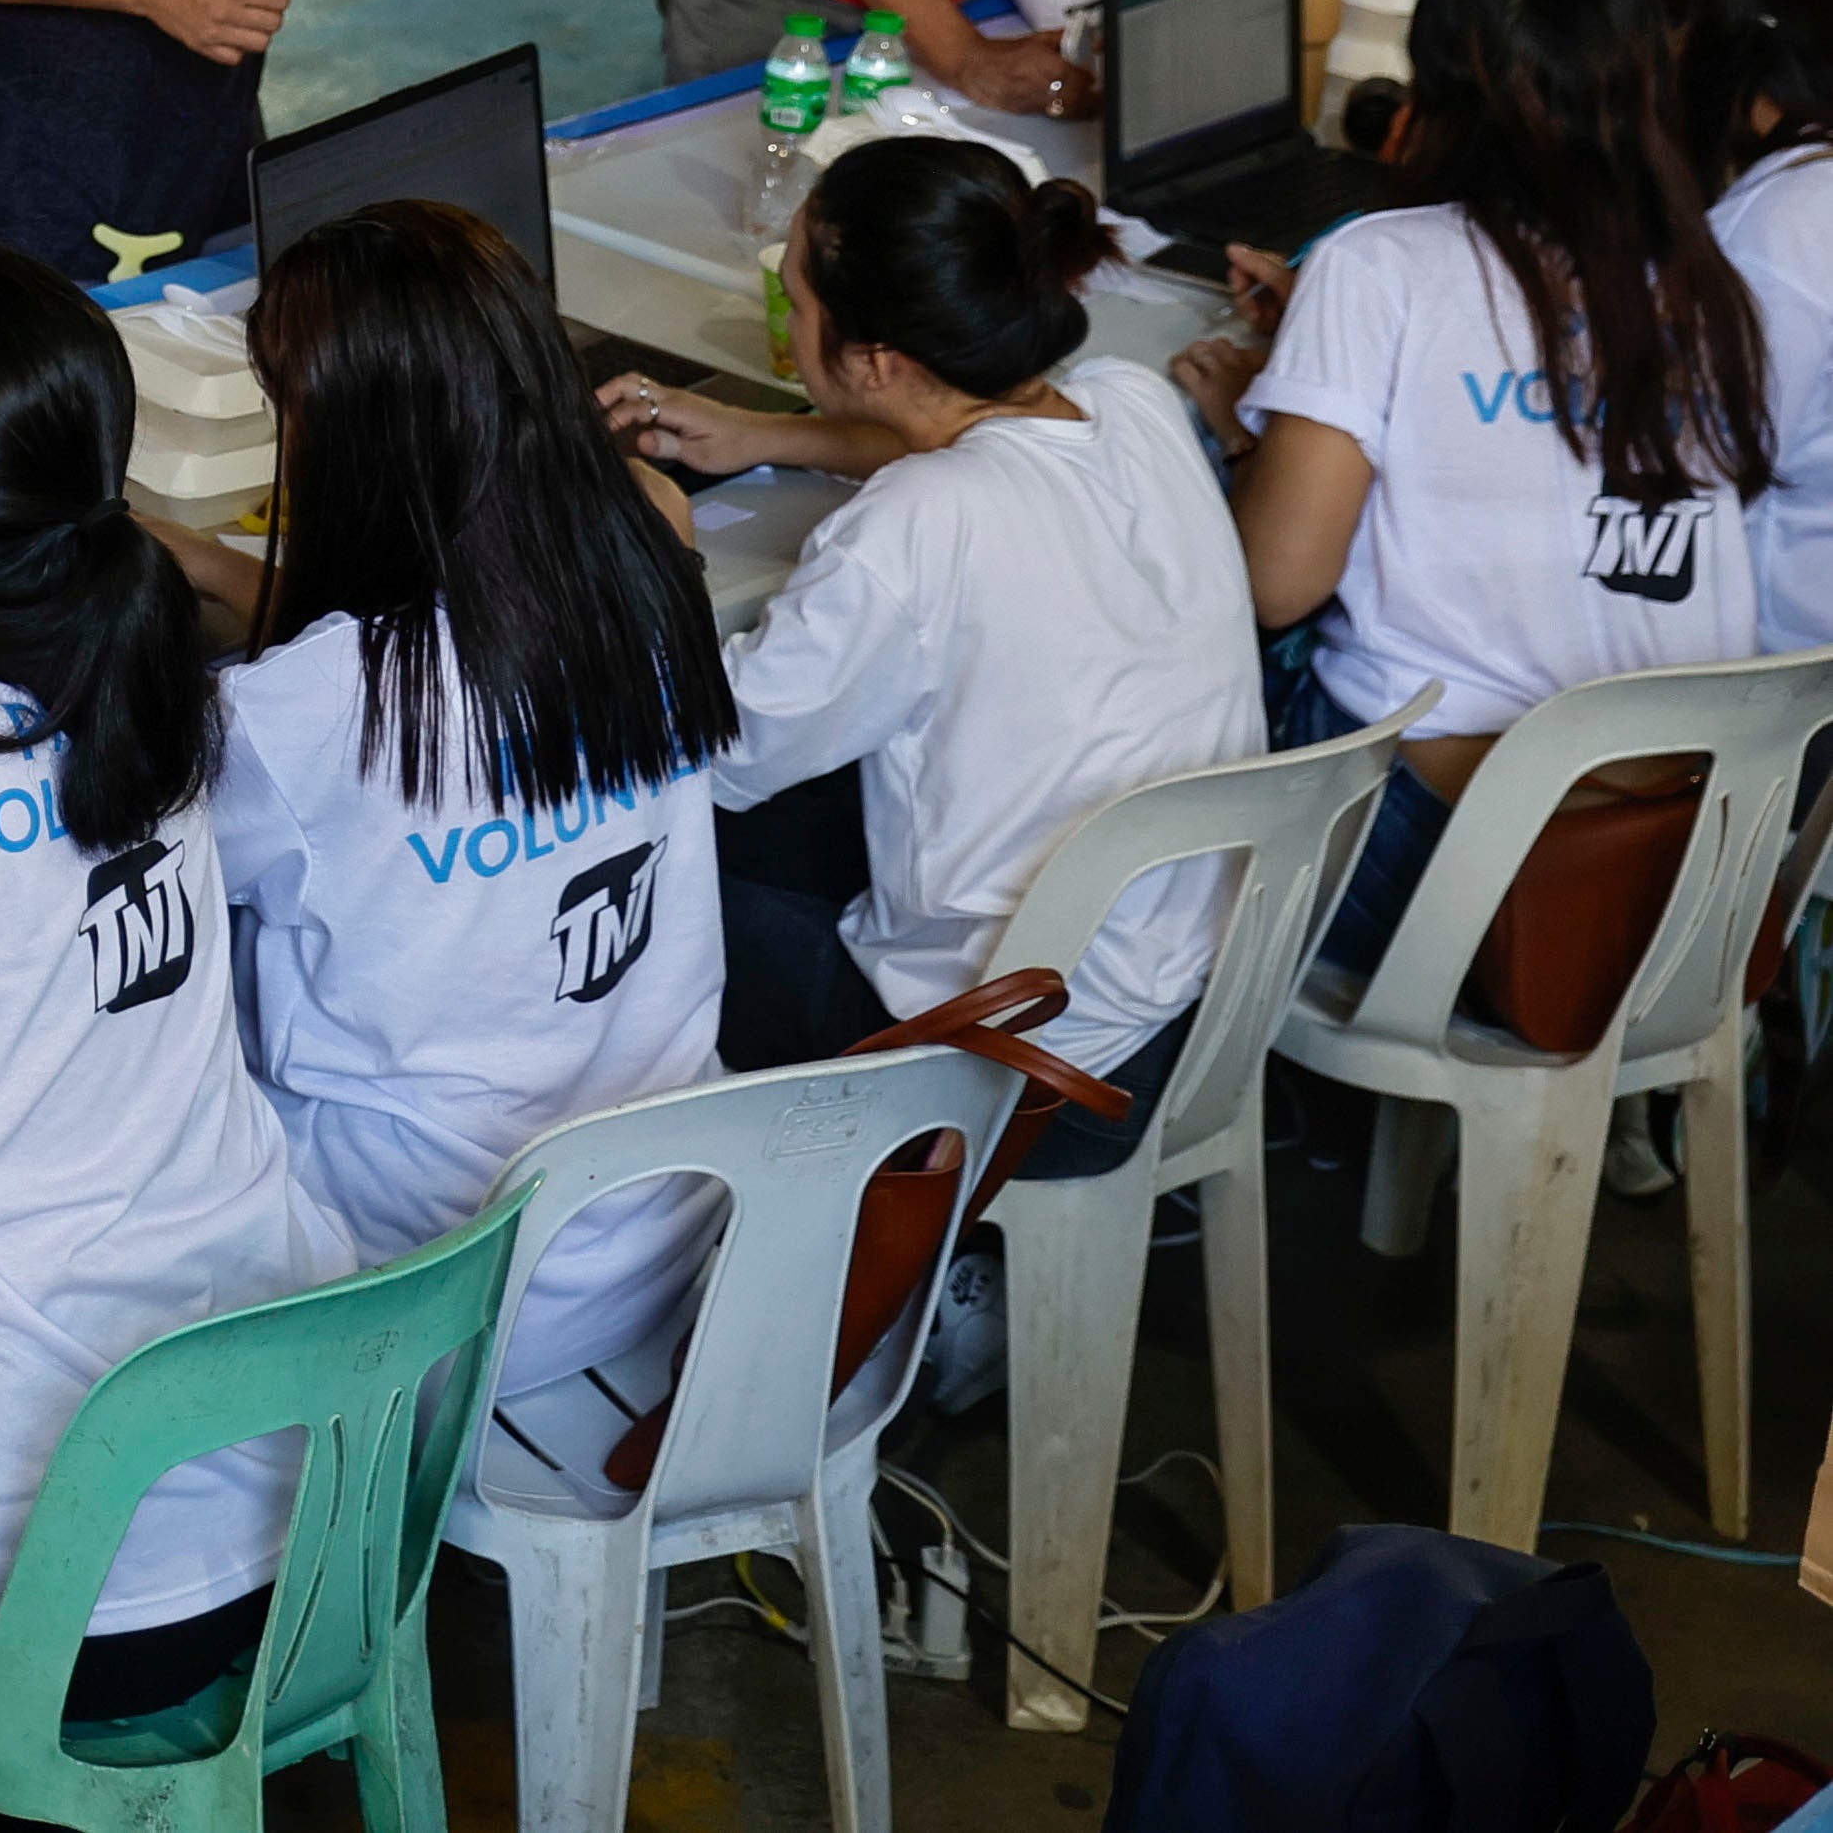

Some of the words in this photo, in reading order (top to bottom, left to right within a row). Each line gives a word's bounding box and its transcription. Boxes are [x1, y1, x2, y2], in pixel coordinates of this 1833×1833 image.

[1582, 494, 1717, 578] TNT
[78, 839, 186, 1014] TNT
[549, 833, 669, 1003] TNT
